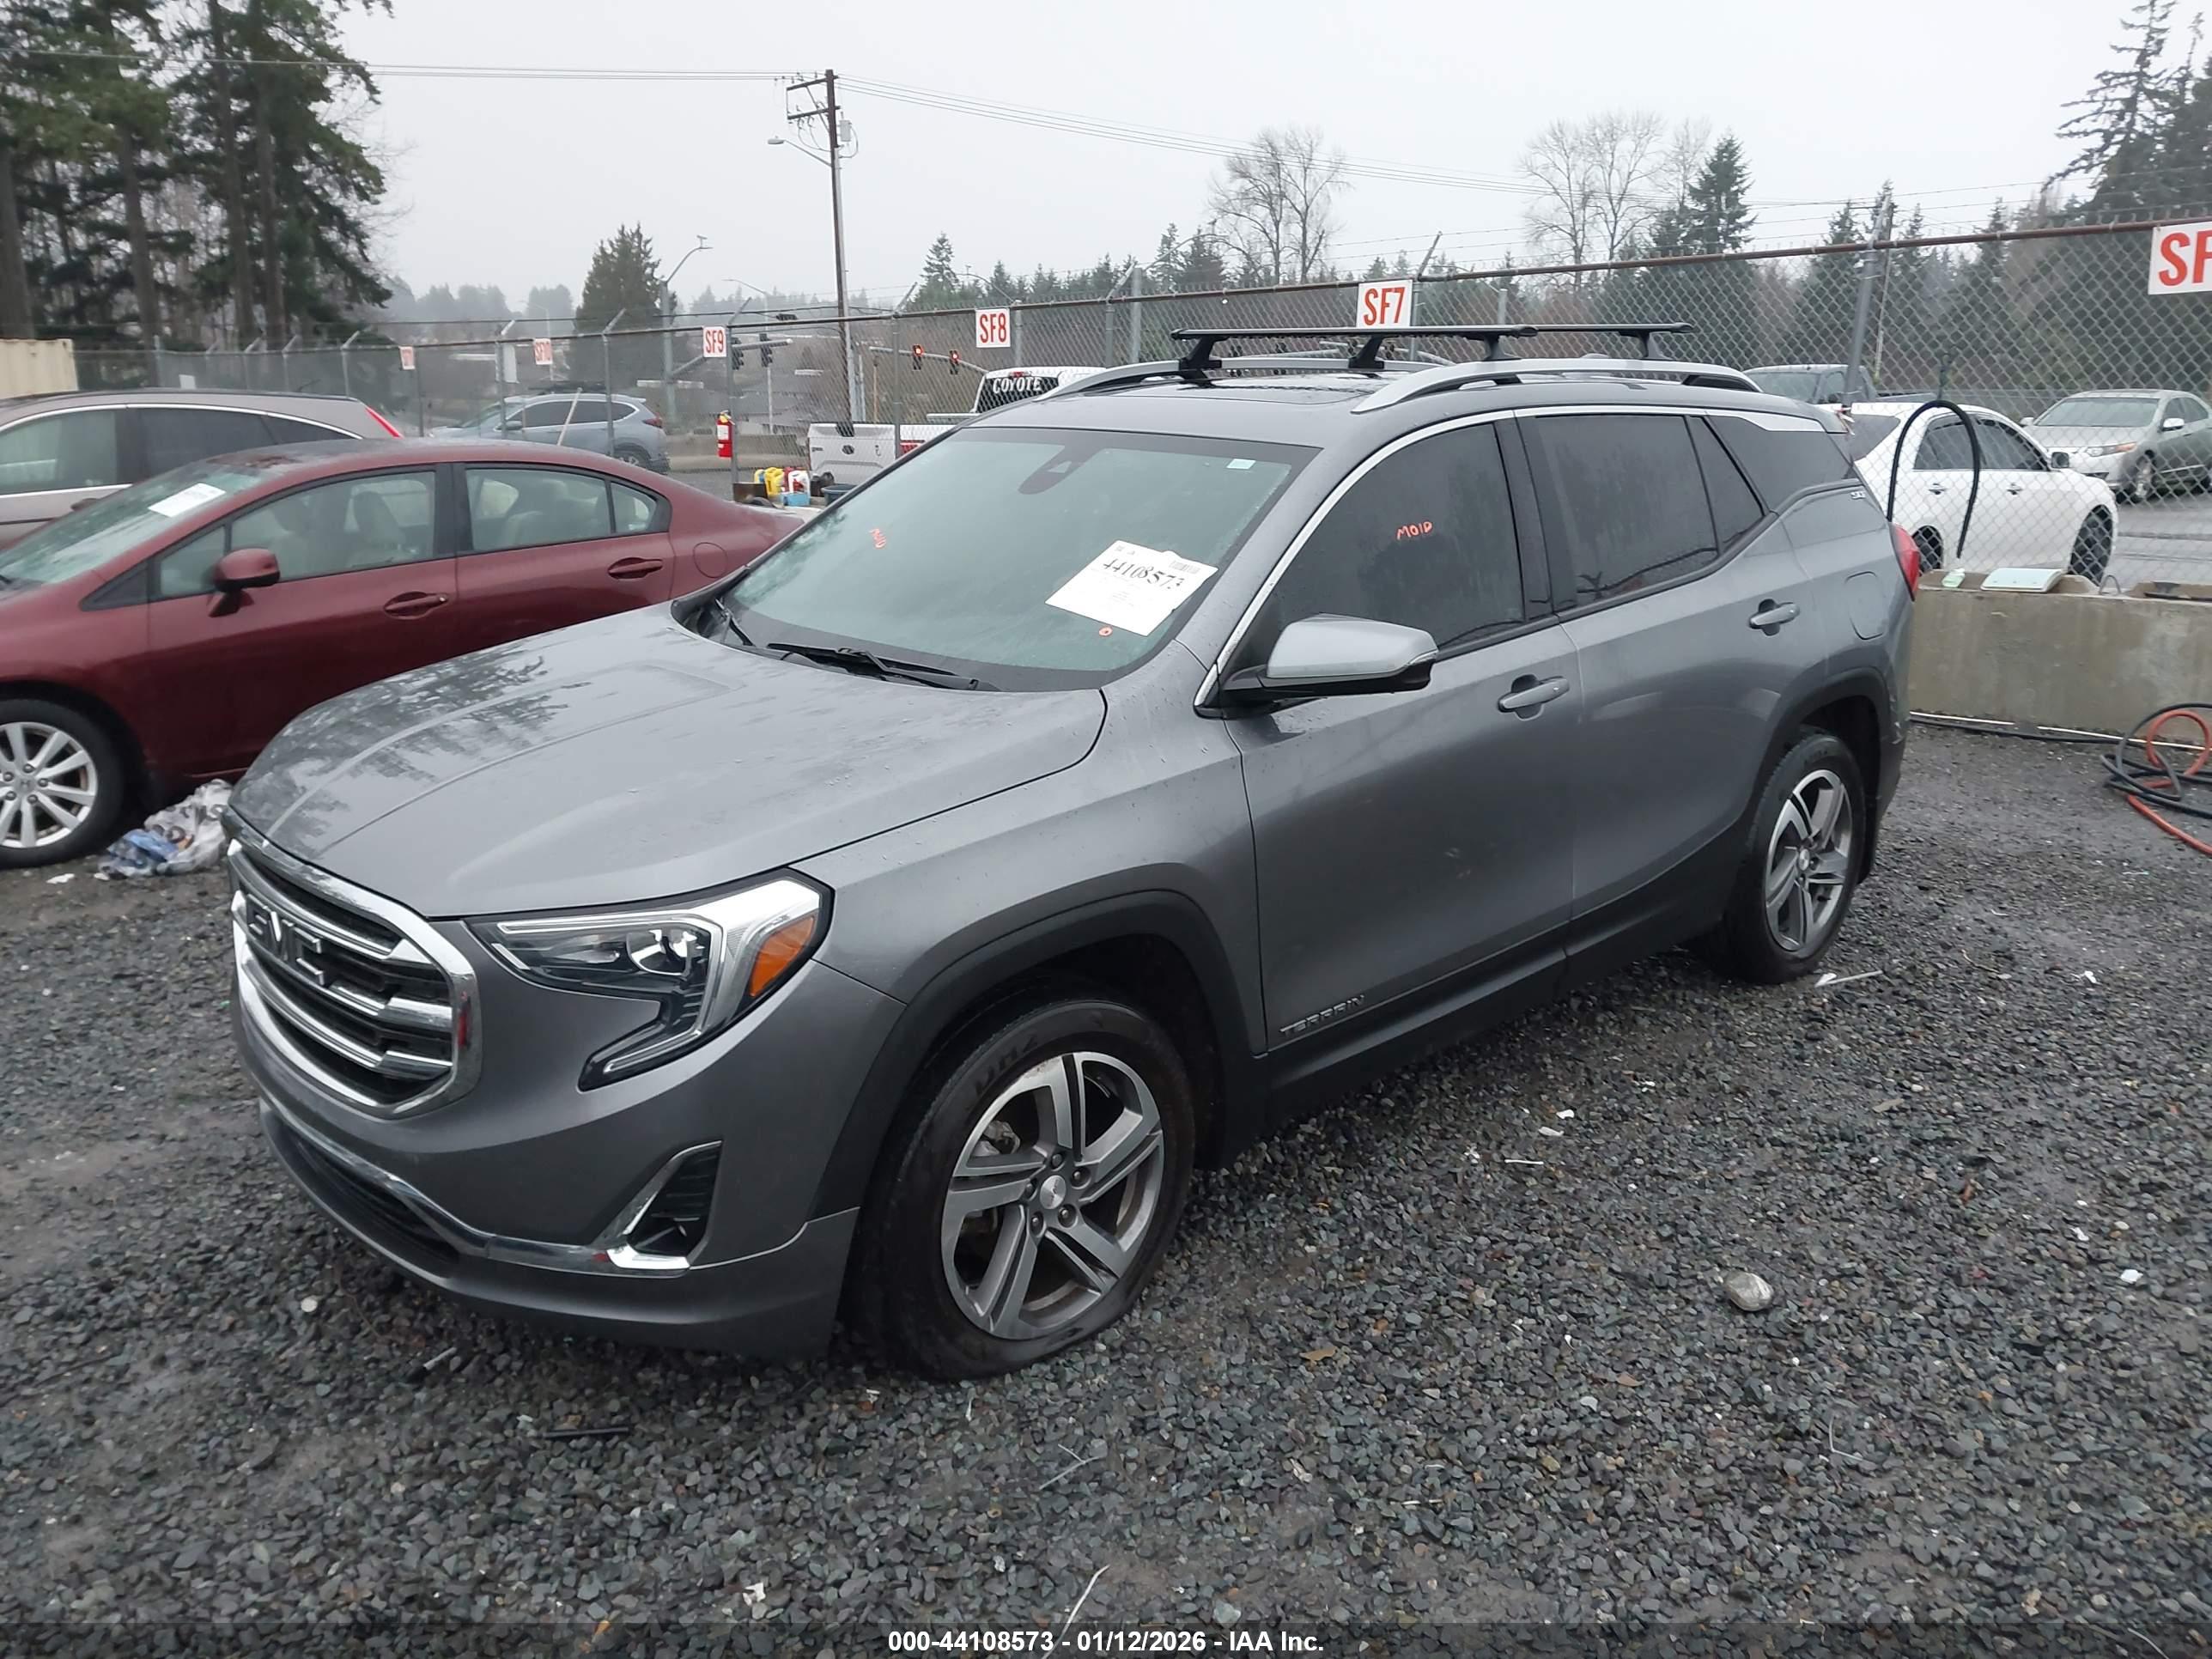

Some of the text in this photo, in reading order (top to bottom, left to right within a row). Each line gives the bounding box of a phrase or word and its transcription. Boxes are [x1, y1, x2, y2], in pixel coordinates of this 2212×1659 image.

[1364, 286, 1406, 325] SF7
[706, 329, 724, 353] SF9
[980, 313, 1007, 343] SF8
[993, 377, 1043, 393] COYOTE
[1103, 558, 1186, 590] 44108573
